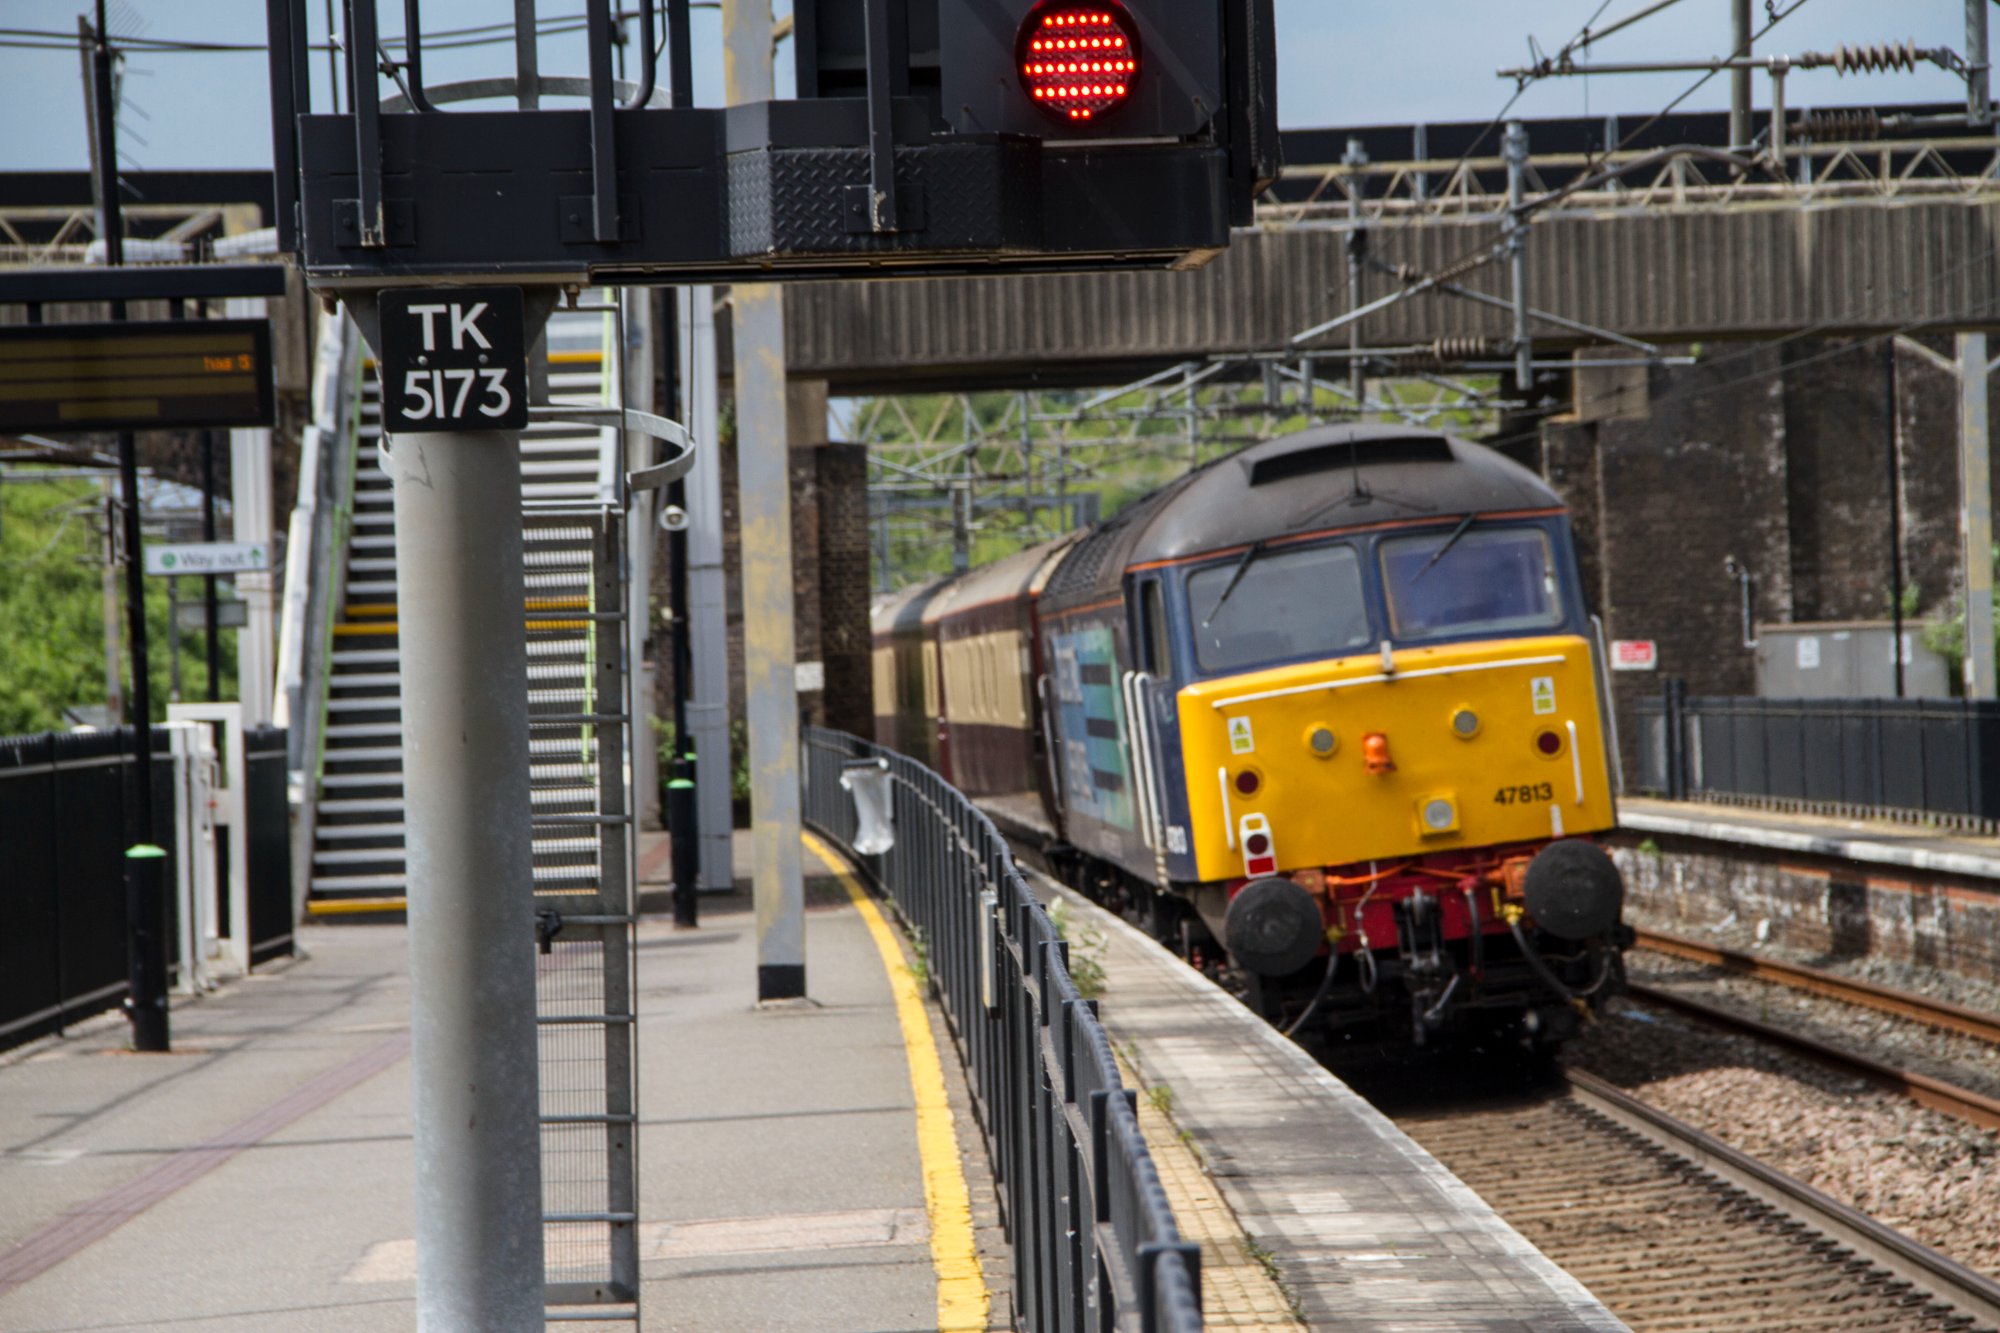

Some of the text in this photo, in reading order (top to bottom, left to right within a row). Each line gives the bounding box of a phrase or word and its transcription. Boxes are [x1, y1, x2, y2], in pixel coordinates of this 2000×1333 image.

[407, 302, 492, 351] TK
[401, 368, 511, 420] 5173
[180, 552, 244, 568] Way out
[1494, 782, 1553, 806] 47813
